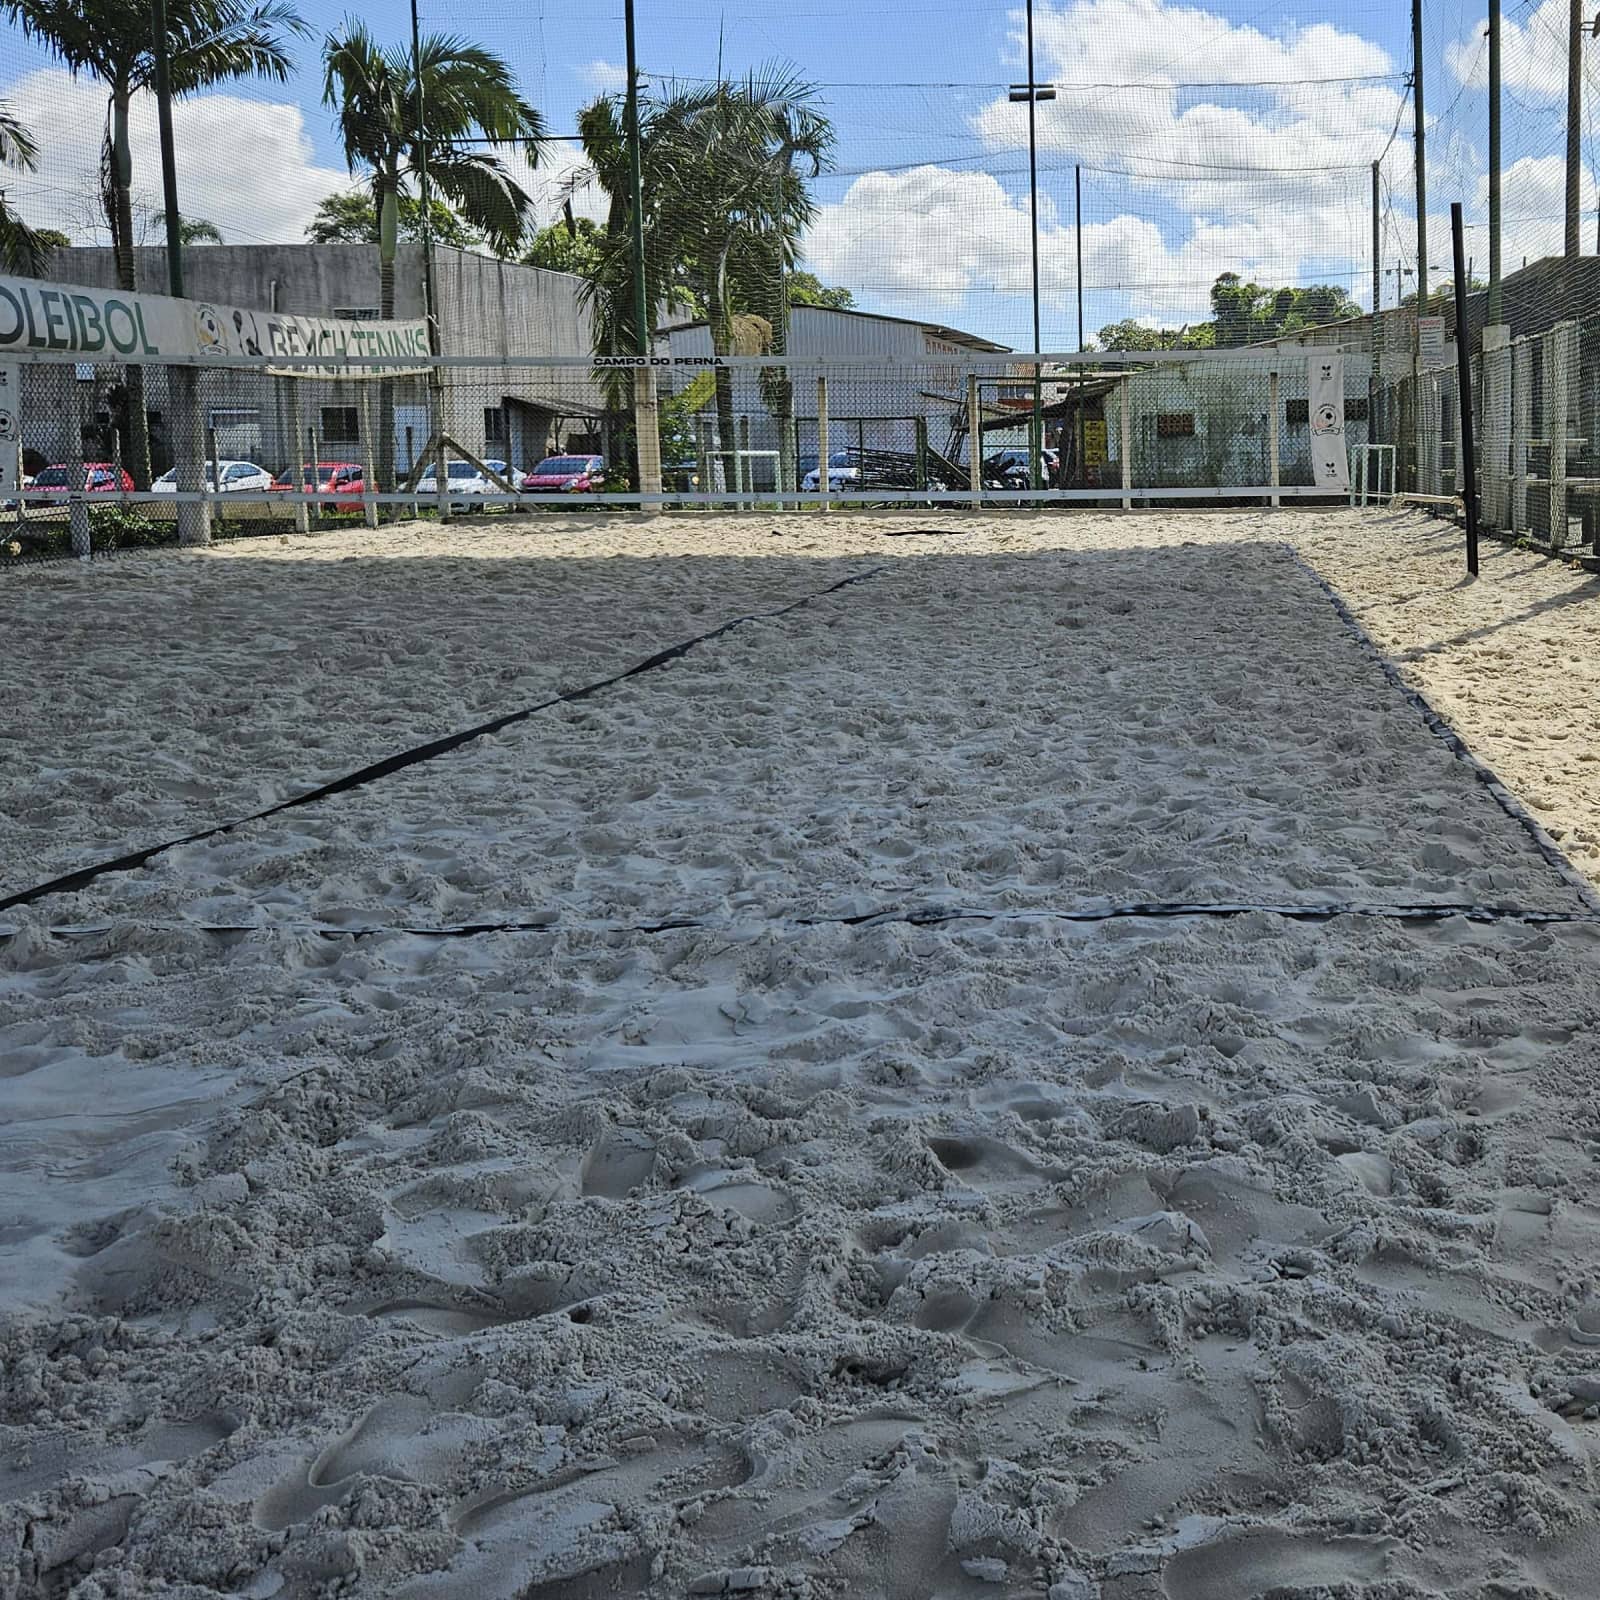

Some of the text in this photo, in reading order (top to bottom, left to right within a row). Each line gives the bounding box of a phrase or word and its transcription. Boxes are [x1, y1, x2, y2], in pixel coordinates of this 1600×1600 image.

[593, 357, 724, 366] CAMPO DO PERNA
